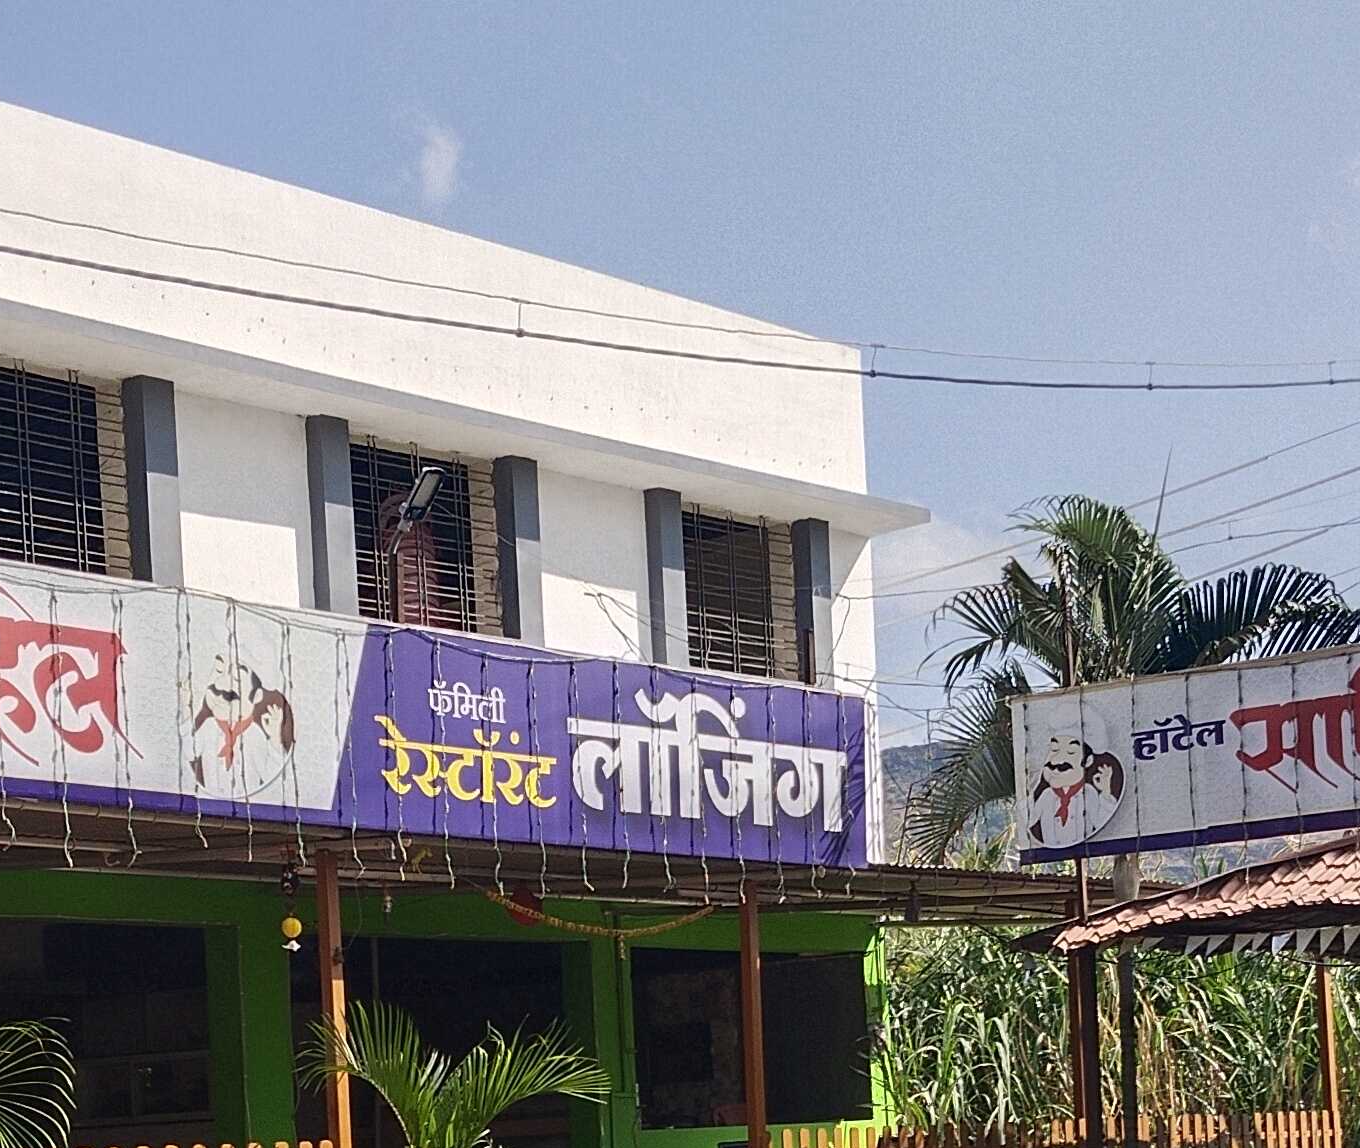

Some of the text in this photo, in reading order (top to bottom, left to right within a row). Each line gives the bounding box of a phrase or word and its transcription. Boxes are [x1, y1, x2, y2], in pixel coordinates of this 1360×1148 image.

[427, 679, 507, 725] फॅमिली
[1131, 713, 1227, 762] हॉटेल
[374, 713, 558, 809] रेस्टॉरंट
[567, 687, 849, 833] लॉजिंग
